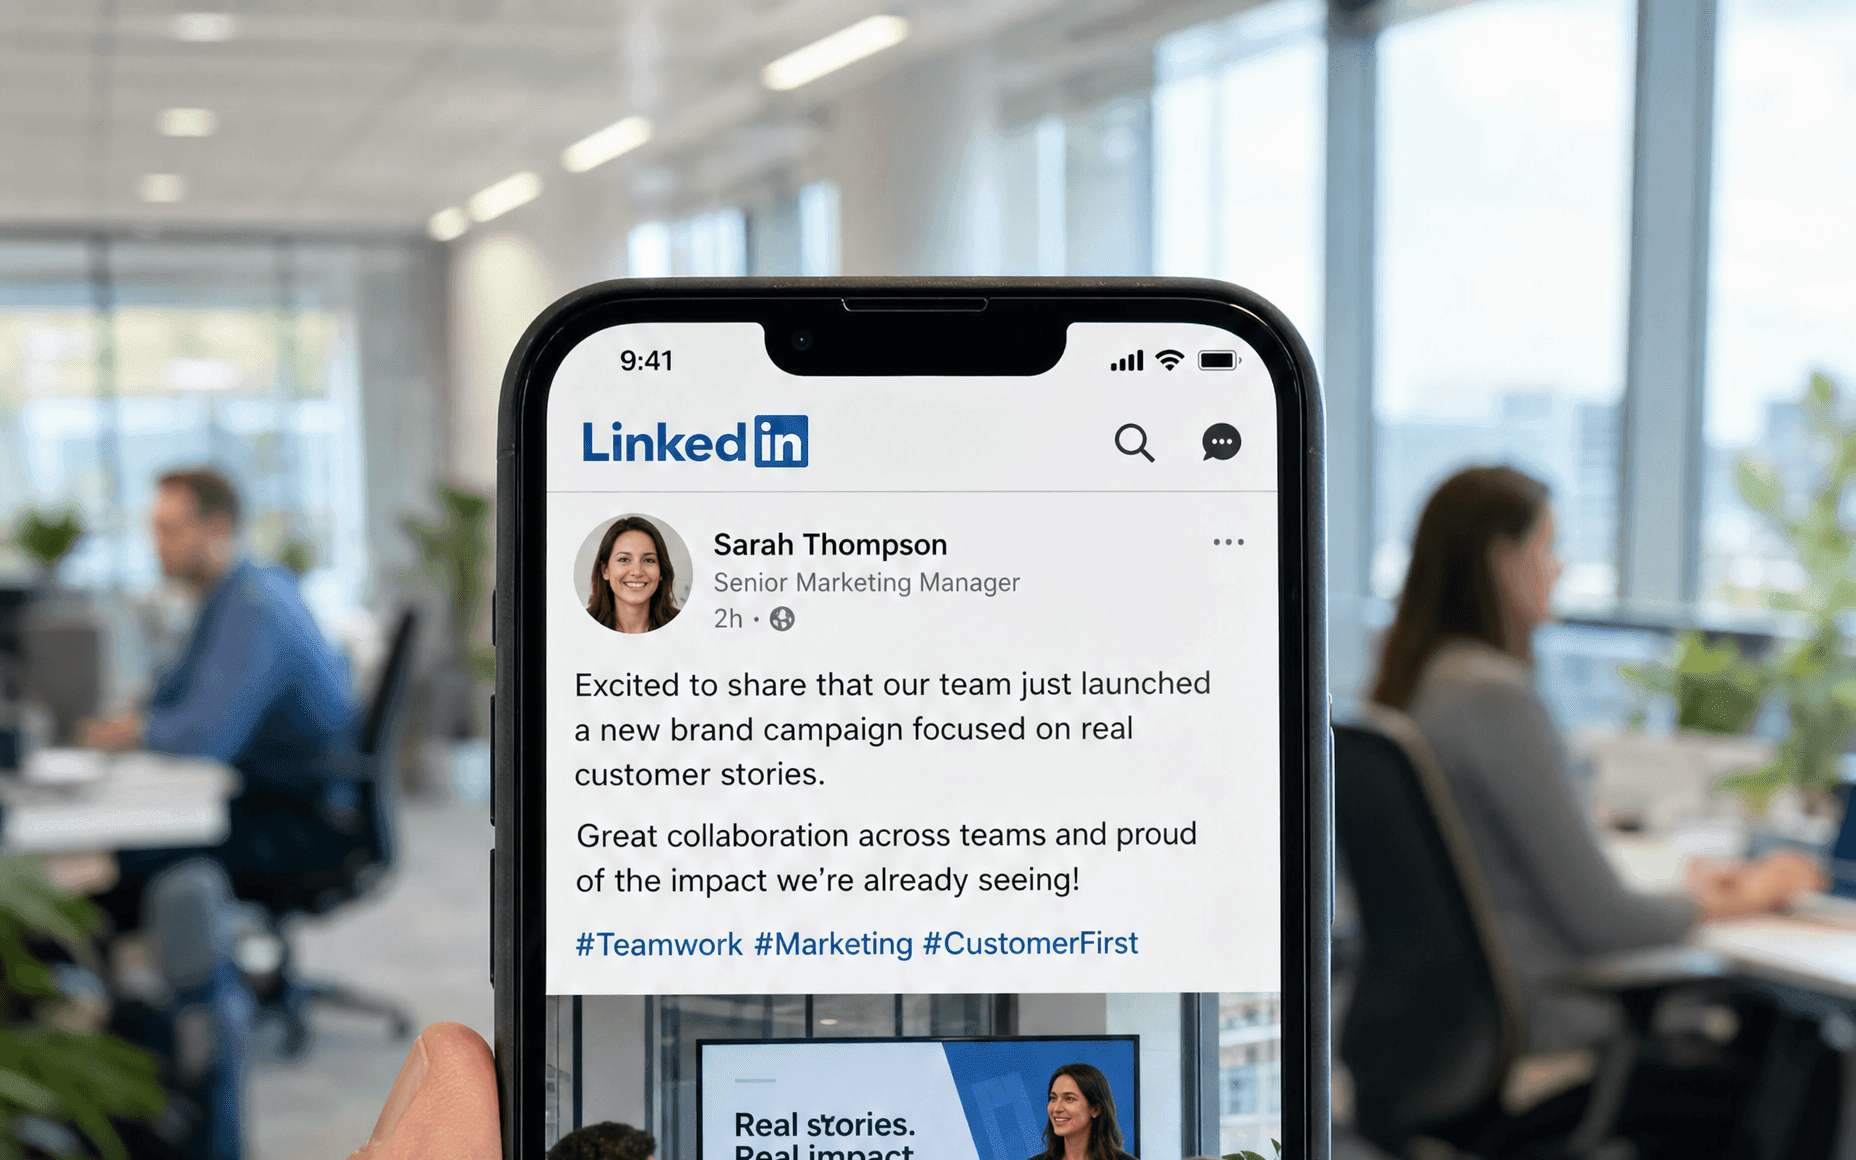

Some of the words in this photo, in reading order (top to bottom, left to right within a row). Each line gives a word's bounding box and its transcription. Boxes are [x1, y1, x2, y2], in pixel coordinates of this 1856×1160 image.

[620, 349, 672, 372] 9:41
[714, 531, 794, 557] Sarah
[802, 532, 947, 562] Thompson
[714, 571, 789, 593] Senior
[796, 571, 911, 598] Marketing
[920, 571, 1021, 598] Manager
[714, 607, 743, 629] 2h
[576, 671, 679, 697] Excited
[689, 674, 718, 697] to
[727, 671, 807, 697] share
[815, 671, 874, 697] that
[883, 677, 931, 697] our
[938, 673, 1011, 696] team
[1019, 670, 1072, 702] just
[1082, 669, 1211, 696] launched
[574, 723, 590, 742] a
[601, 723, 661, 742] new
[671, 716, 753, 742] brand
[763, 716, 903, 748] campaign
[912, 715, 1025, 741] focused
[1035, 721, 1071, 741] on
[1082, 714, 1133, 740] real
[574, 763, 712, 787] customer
[721, 760, 825, 786] stories.
[577, 822, 658, 848] Great
[667, 822, 849, 848] collaboration
[858, 828, 951, 848] across
[959, 824, 1047, 847] teams
[1055, 820, 1107, 846] and
[1117, 820, 1197, 852] proud
[576, 867, 606, 893] of
[614, 867, 661, 893] the
[671, 867, 768, 899] impact
[776, 866, 854, 892] we’re
[863, 866, 969, 899] already
[978, 866, 1079, 898] seeing!
[575, 931, 744, 957] #Teamwork
[753, 930, 913, 962] #Marketing
[922, 929, 1139, 956] #CustomerFirst
[735, 1111, 798, 1138] Real
[806, 1111, 916, 1137] stories.
